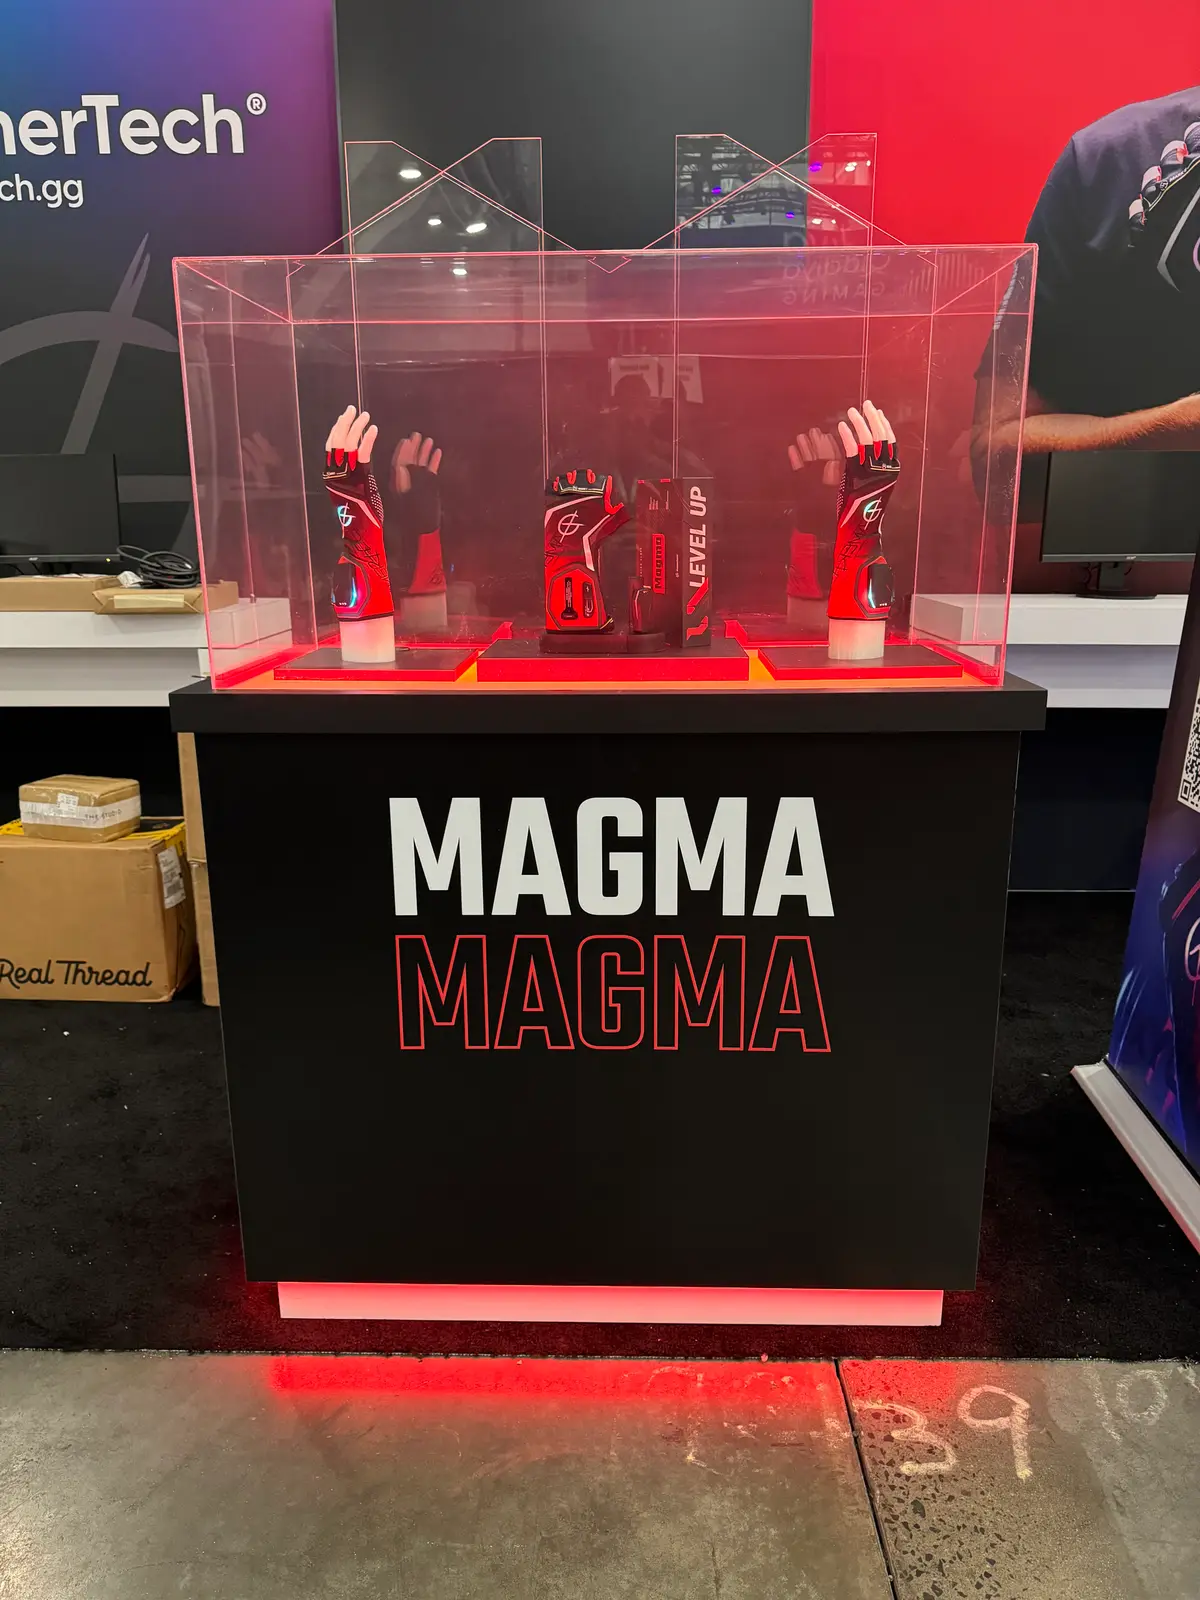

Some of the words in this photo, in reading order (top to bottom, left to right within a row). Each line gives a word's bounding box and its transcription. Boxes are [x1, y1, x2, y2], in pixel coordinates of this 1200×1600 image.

[689, 486, 708, 517] UP
[654, 536, 663, 589] Magma
[689, 524, 706, 588] LEVEL
[389, 797, 835, 917] MAGMA
[0, 958, 55, 990] Real
[56, 960, 153, 987] Thread
[395, 935, 832, 1052] MAGMA
